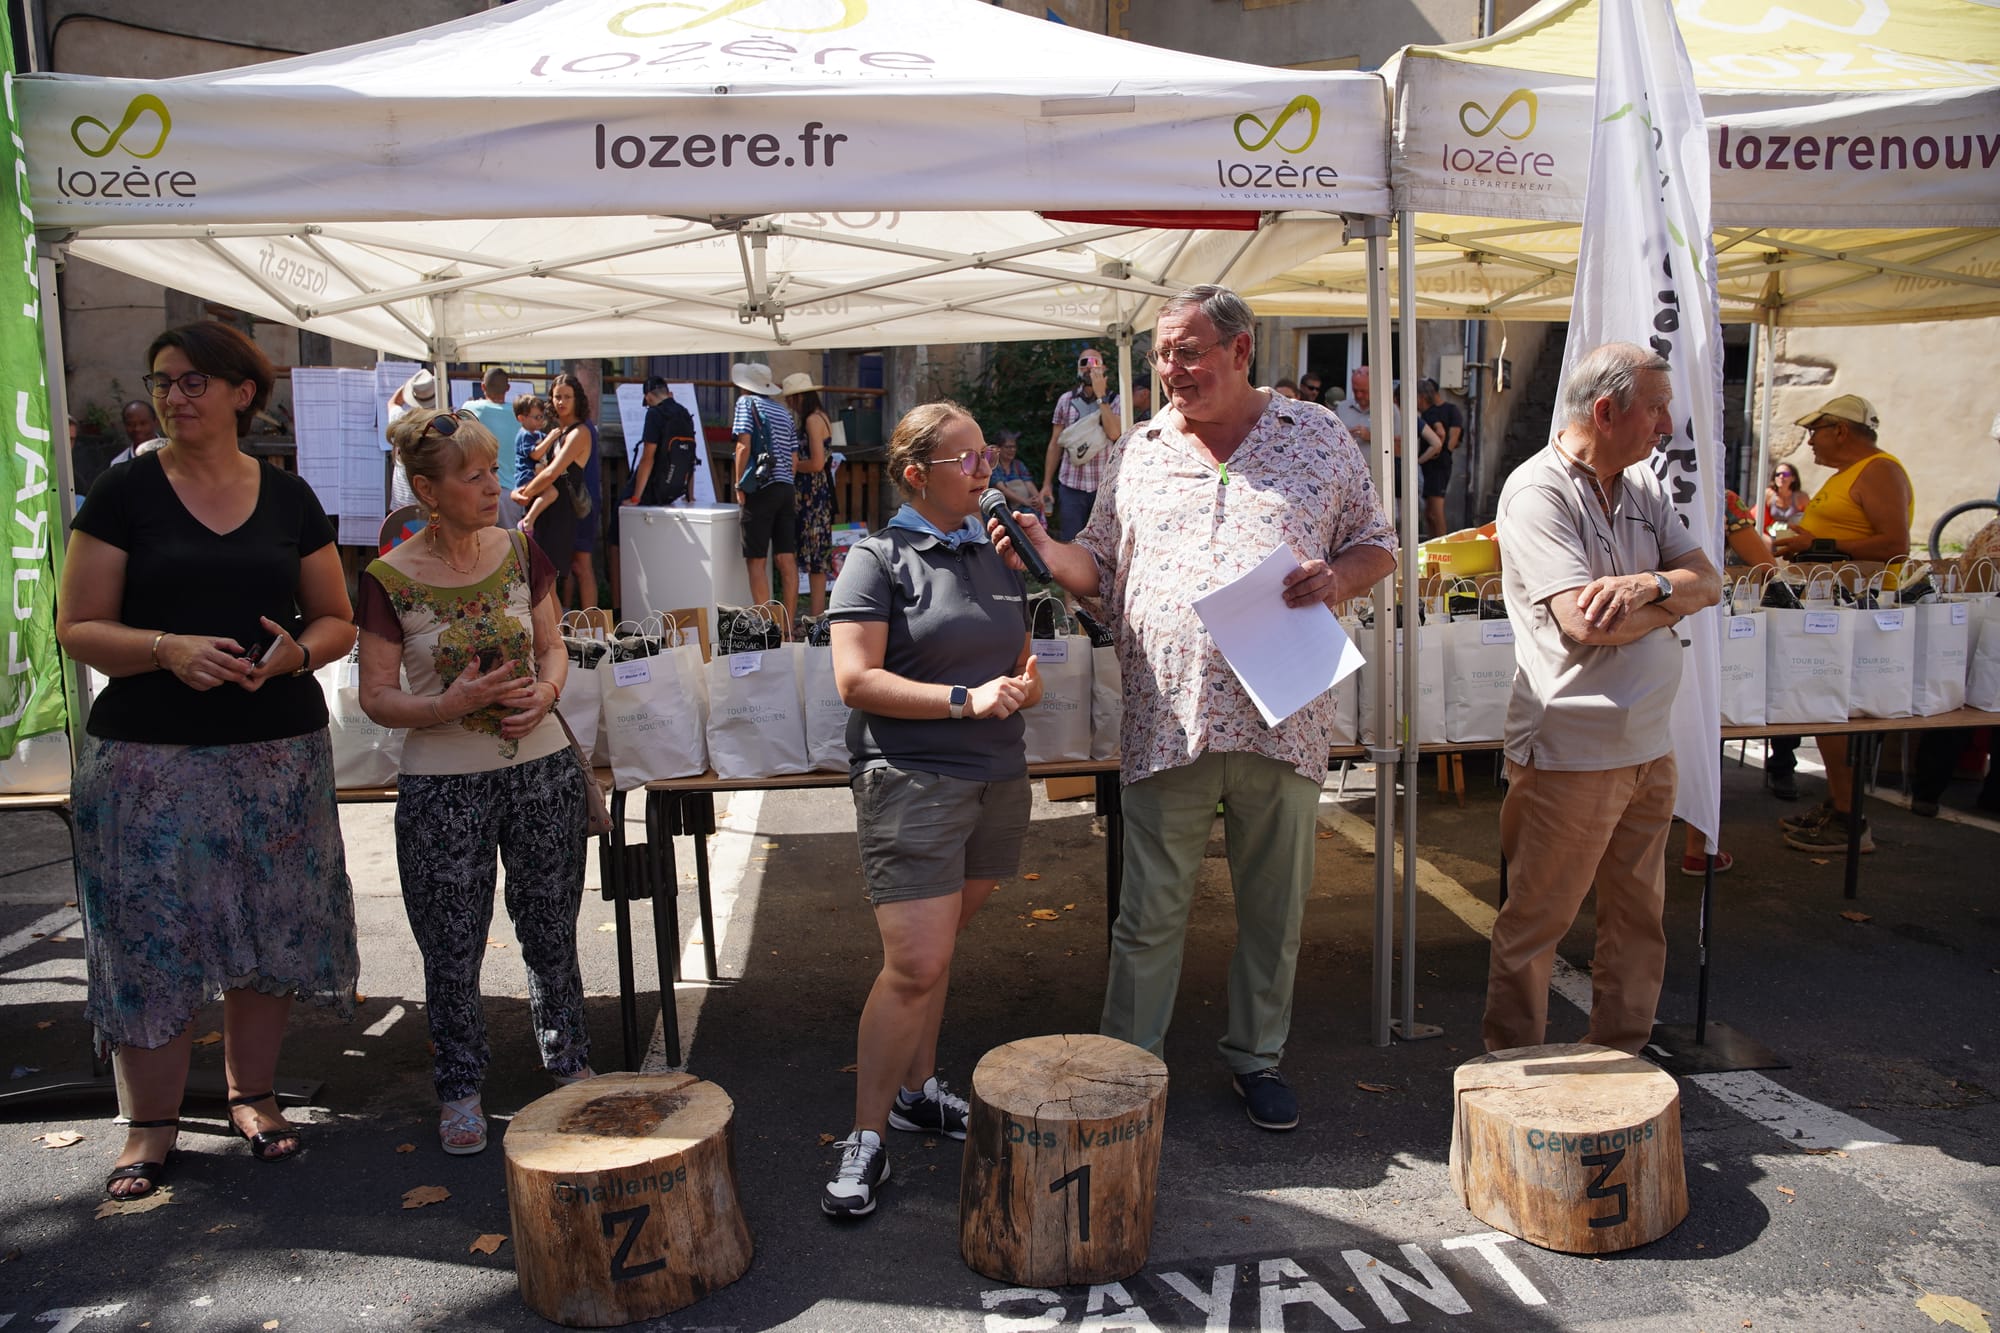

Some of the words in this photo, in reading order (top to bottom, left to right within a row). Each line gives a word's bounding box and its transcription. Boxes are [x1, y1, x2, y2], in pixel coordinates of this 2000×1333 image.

[595, 121, 848, 170] lozere.fr
[1442, 143, 1555, 177] lozère
[1718, 124, 2000, 171] lozerenouv
[57, 165, 197, 198] lozère
[1217, 159, 1339, 188] lozère
[1442, 177, 1456, 186] LE
[1007, 1120, 1057, 1148] Des
[555, 1165, 687, 1204] Challenge
[1581, 1149, 1628, 1228] 3
[1050, 1165, 1092, 1242] 1
